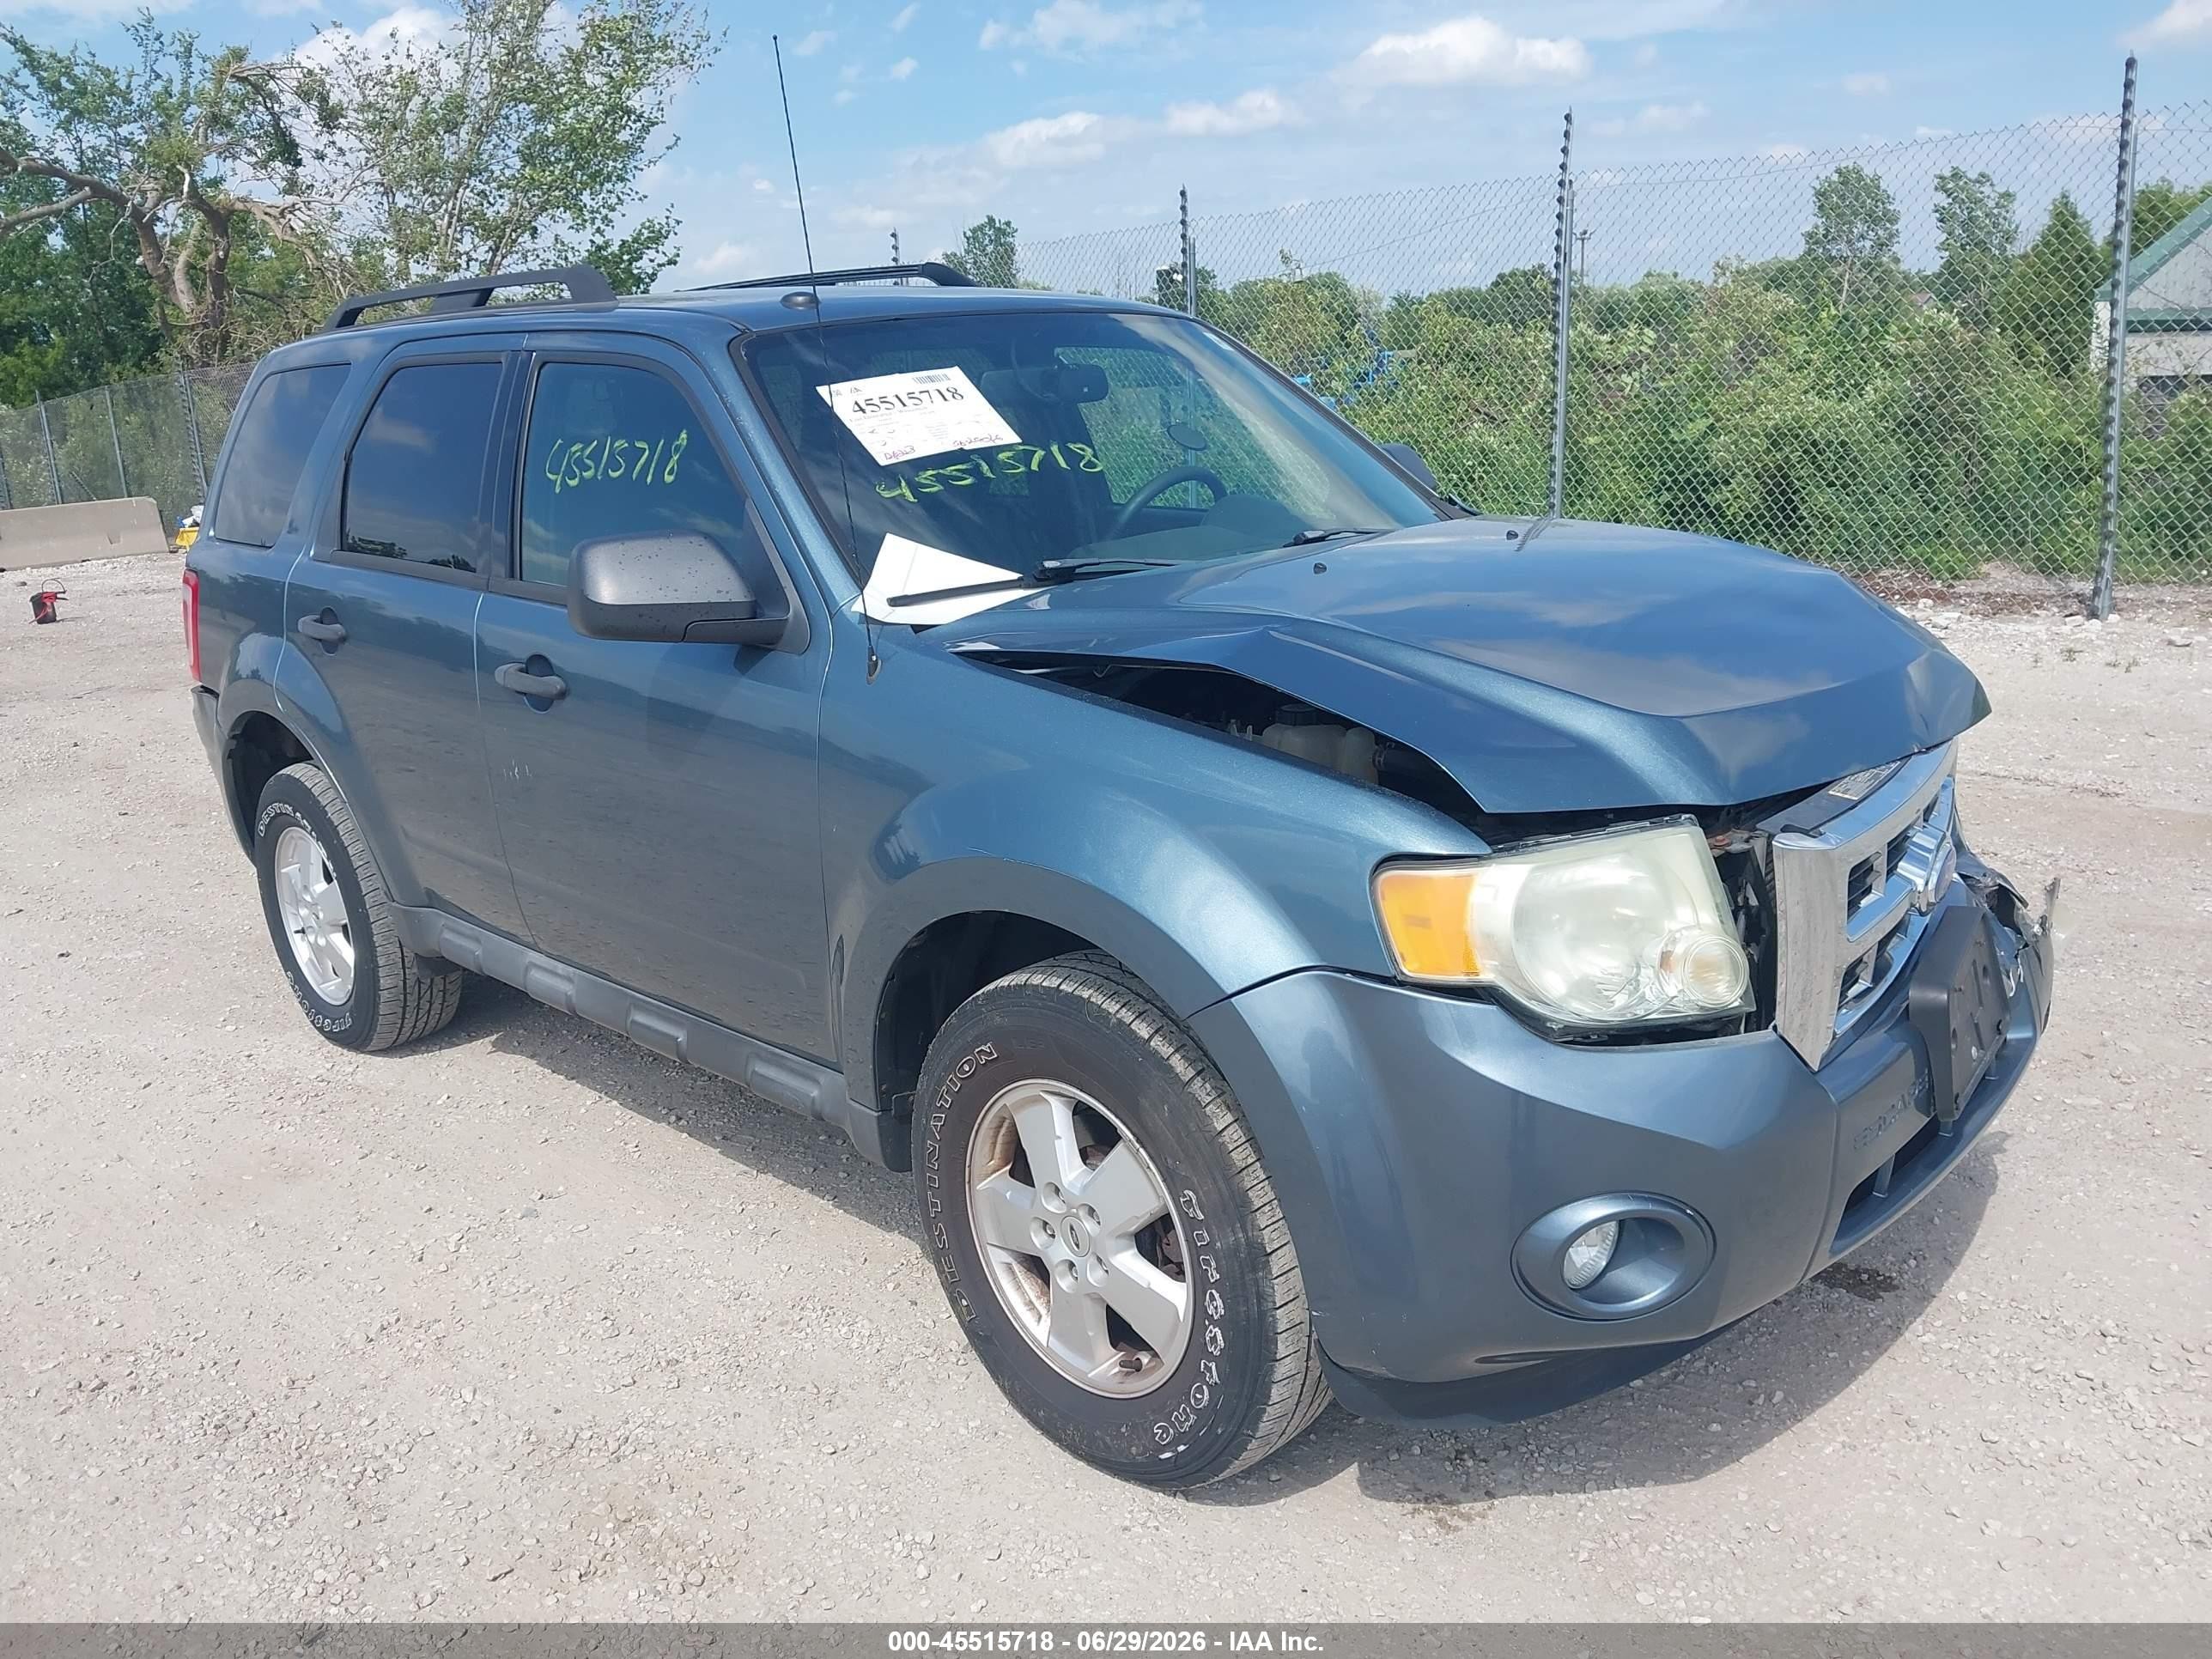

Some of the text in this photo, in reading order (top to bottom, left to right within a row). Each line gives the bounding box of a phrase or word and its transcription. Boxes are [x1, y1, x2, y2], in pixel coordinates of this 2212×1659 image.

[852, 386, 964, 415] 45515718
[545, 429, 687, 494] 45515718
[875, 441, 1104, 503] 45515718
[928, 1042, 998, 1322] DESTINATION
